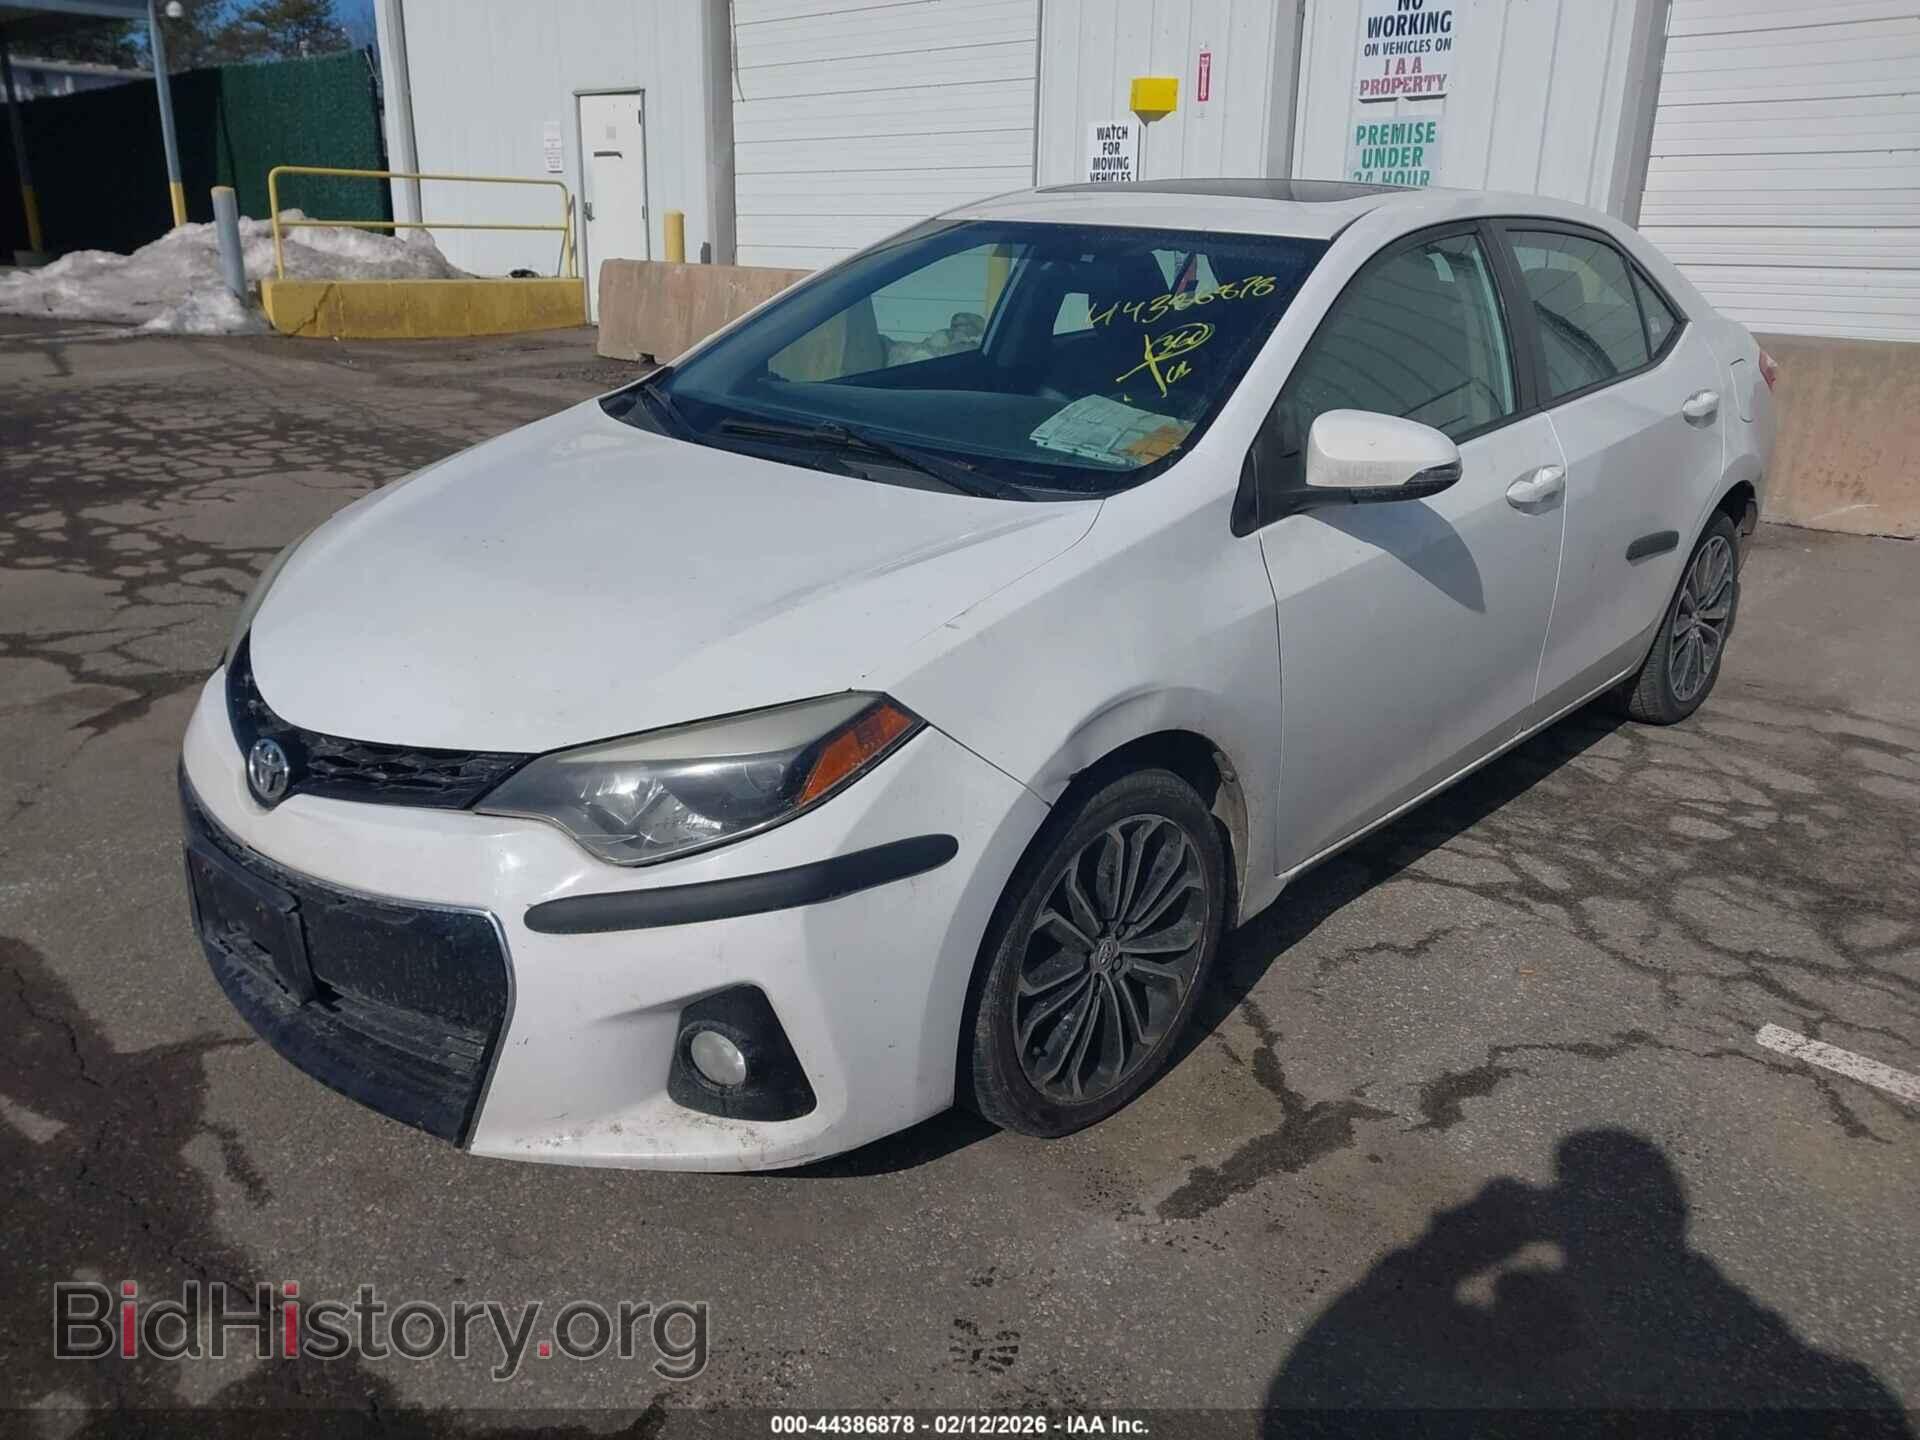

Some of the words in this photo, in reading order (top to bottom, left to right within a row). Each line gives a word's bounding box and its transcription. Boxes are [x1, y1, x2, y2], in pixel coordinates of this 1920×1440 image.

[1367, 10, 1452, 39] WORKING
[1364, 43, 1379, 57] ON
[1382, 38, 1431, 55] VEHICLES
[1435, 37, 1452, 52] ON
[1359, 73, 1448, 96] PROPERTY
[1096, 126, 1128, 141] WATCH
[1356, 121, 1436, 146] PREMISE
[1102, 142, 1121, 155] FOR
[1092, 157, 1129, 171] MOVING
[1361, 147, 1424, 169] UNDER
[1089, 171, 1131, 182] VEHICLES
[1382, 170, 1430, 186] HOUR
